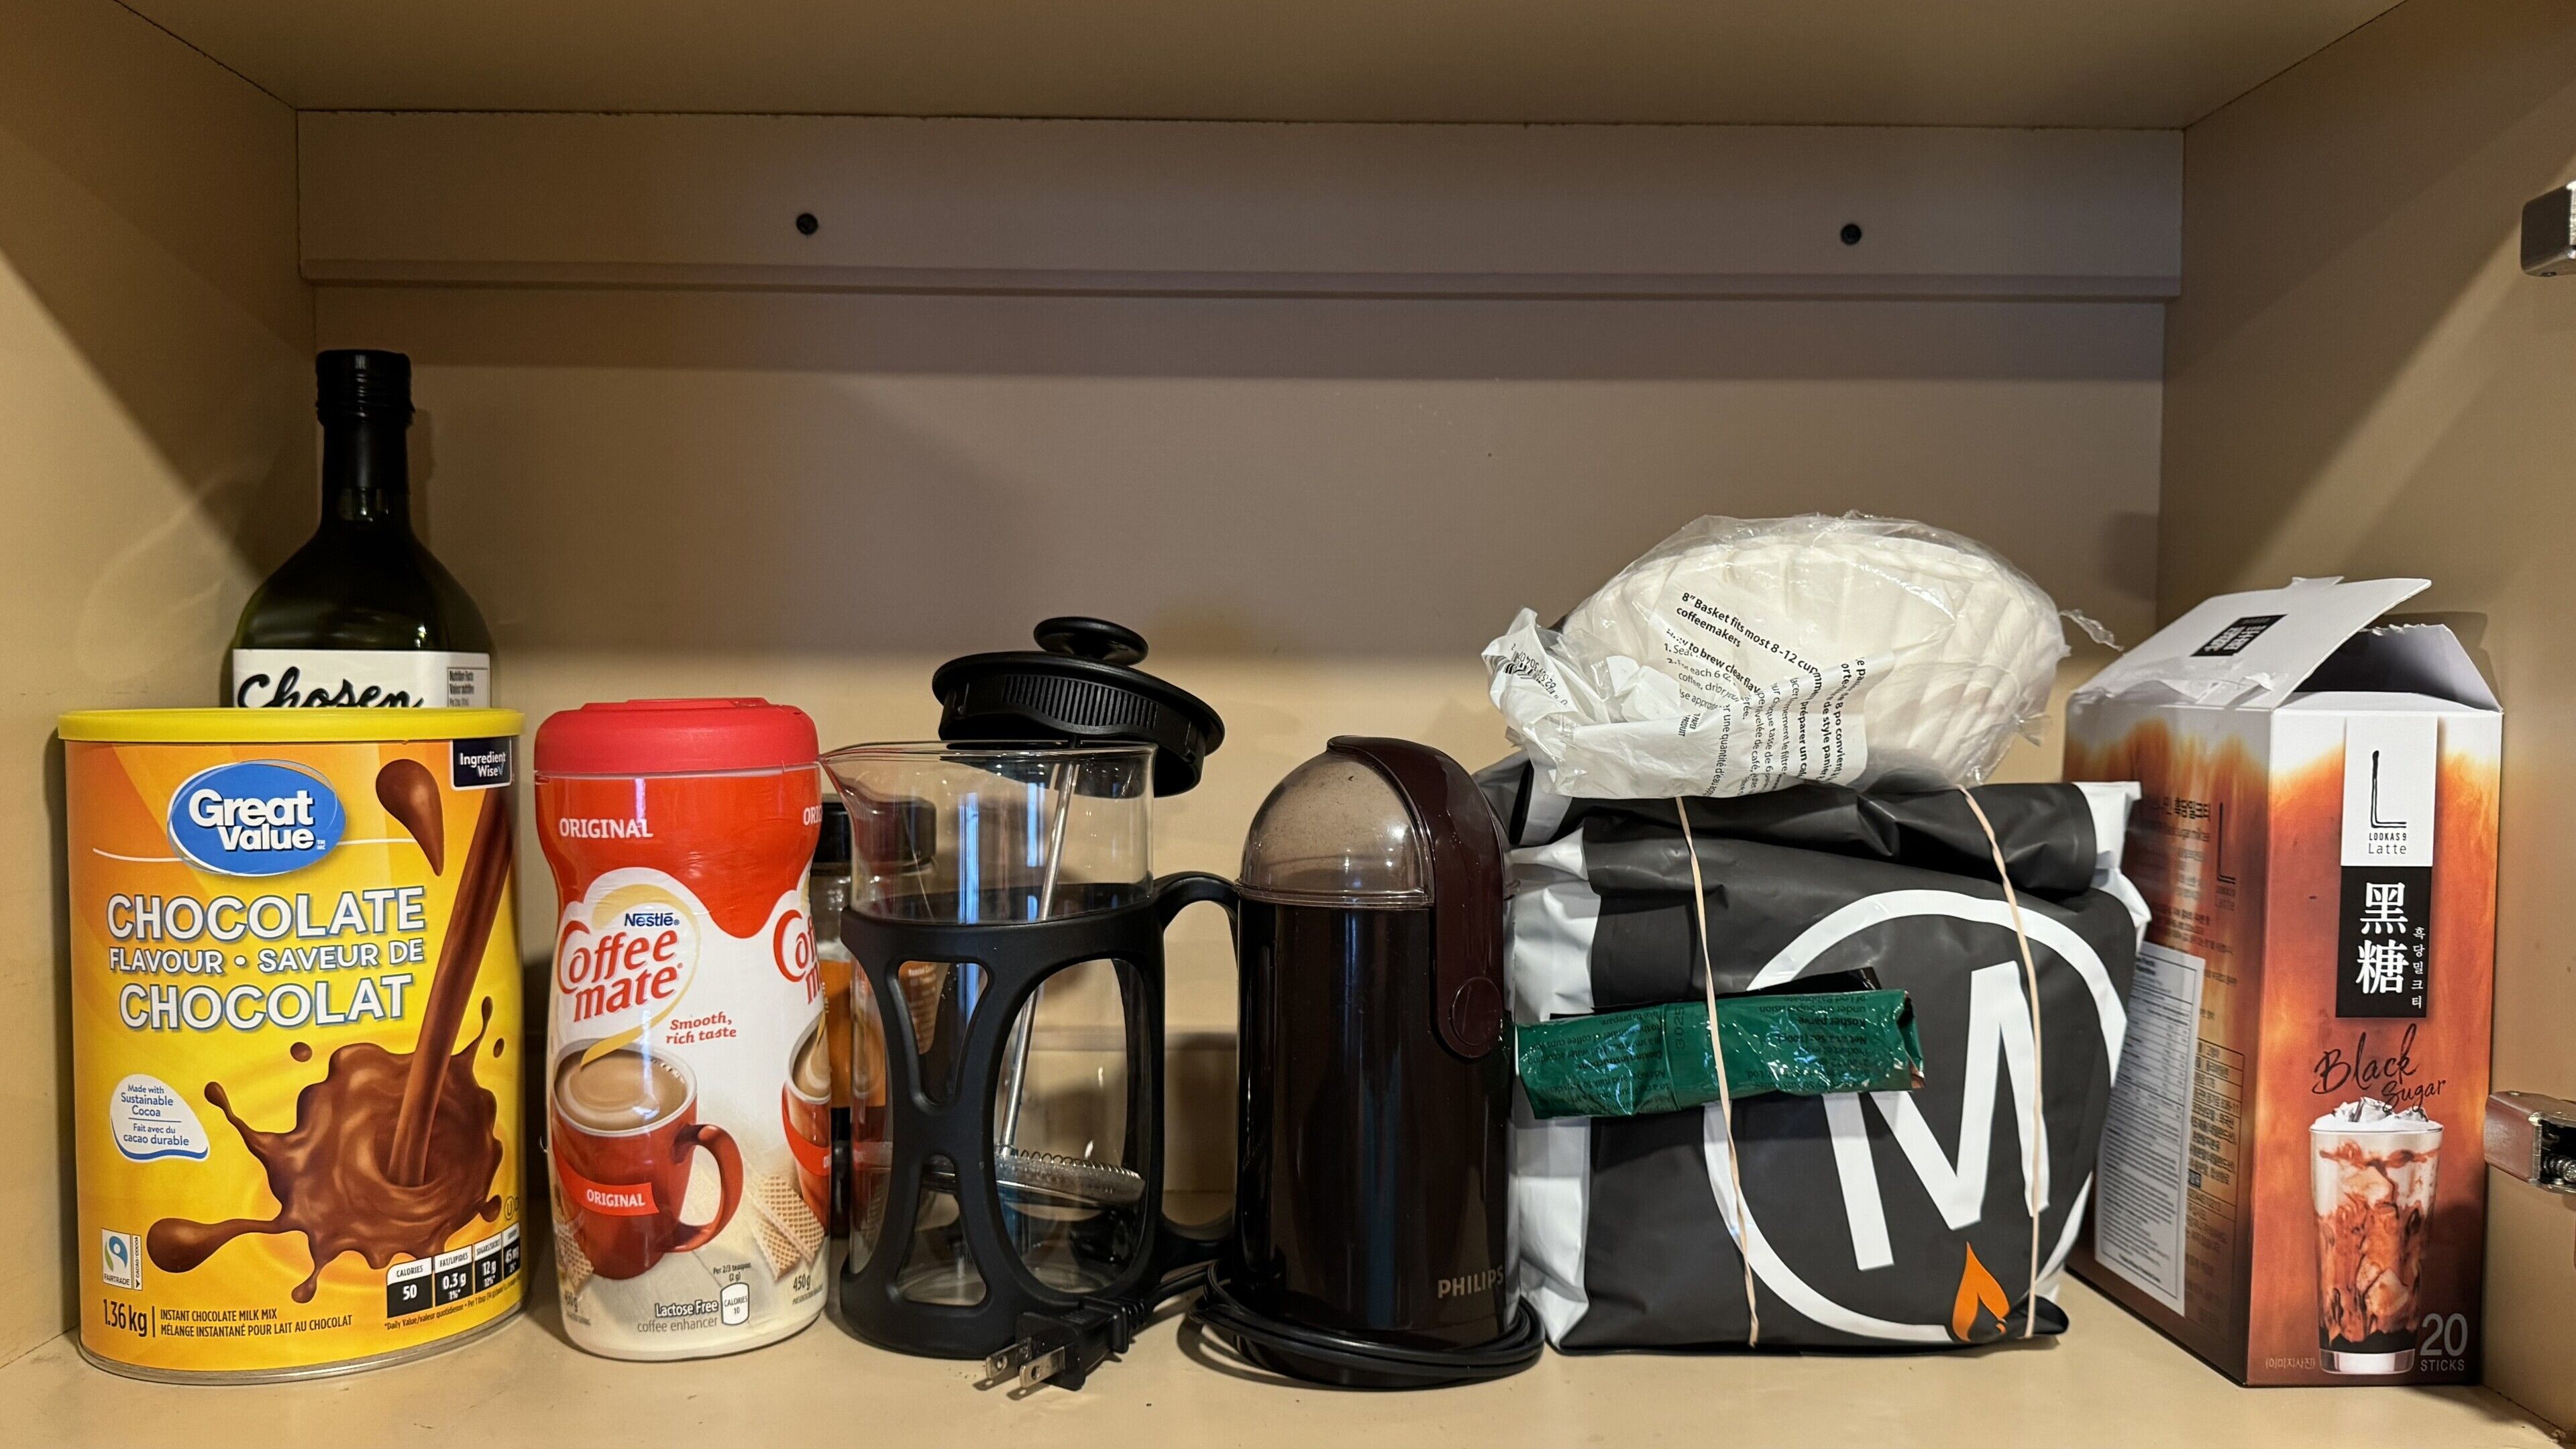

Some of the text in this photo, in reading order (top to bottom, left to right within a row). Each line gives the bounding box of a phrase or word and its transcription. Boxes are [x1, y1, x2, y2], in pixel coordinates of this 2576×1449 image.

[1676, 606, 1741, 648] coffeemakers
[1694, 598, 1731, 624] Basket
[1730, 616, 1745, 633] fits
[1744, 629, 1771, 649] most
[1688, 642, 1700, 654] to
[1700, 647, 1725, 669] brew
[1725, 664, 1744, 683] clear
[1690, 668, 1712, 678] each
[237, 665, 425, 708] Chosen
[1822, 701, 1832, 715] de
[1723, 714, 1731, 733] une
[1797, 700, 1809, 746] préparer
[1833, 710, 1842, 727] po
[1766, 728, 1775, 750] tasse
[1821, 717, 1833, 743] style
[1716, 733, 1729, 767] quantité
[1753, 739, 1763, 750] de
[1799, 746, 1808, 761] un
[460, 751, 506, 767] Ingredient
[1764, 751, 1774, 764] de
[477, 765, 498, 777] Wise
[189, 789, 315, 828] Great
[559, 818, 653, 839] ORIGINAL
[218, 826, 315, 851] Value
[2368, 843, 2407, 855] Latte
[106, 885, 425, 941] CHOCOLATE
[2355, 881, 2410, 994] 黑糖
[109, 937, 425, 975] FLAVOUR SAVEUR DE
[557, 920, 679, 996] Coffee
[119, 972, 413, 1030] CHOCOLAT
[573, 962, 680, 1023] mate
[669, 1011, 733, 1032] Smooth,
[666, 1026, 737, 1044] rich taste
[2312, 1023, 2420, 1094] Black
[127, 1084, 164, 1094] Made with
[2381, 1079, 2447, 1113] Sugar
[121, 1092, 174, 1106] Sustainable
[131, 1105, 161, 1117] Cocoa
[133, 1123, 146, 1132] Fait
[166, 1126, 176, 1134] du
[123, 1134, 189, 1146] cacao durable
[586, 1189, 646, 1208] ORIGINAL
[396, 1265, 423, 1278] CALORIES
[439, 1252, 469, 1268] FAT/LIPIDES
[482, 1261, 491, 1276] 12
[104, 1273, 130, 1286] FAIRTRADE
[442, 1273, 467, 1290] 0.3 g
[1437, 1264, 1504, 1299] PHILIPS
[402, 1284, 418, 1301] 50
[724, 1295, 749, 1307] CALORIES
[103, 1298, 148, 1338] 1.36 kg
[160, 1307, 278, 1323] INSTANT CHOCOLATE MILK MIX
[655, 1299, 719, 1318] Lactose Free
[734, 1306, 741, 1315] 10
[161, 1314, 354, 1338] MÉLANGE INSTANTANÉ POUR LAIT AU CHOCOLAT
[637, 1317, 718, 1332] coffee enhancer
[2419, 1312, 2469, 1357] 20
[2420, 1358, 2465, 1372] STICKS
